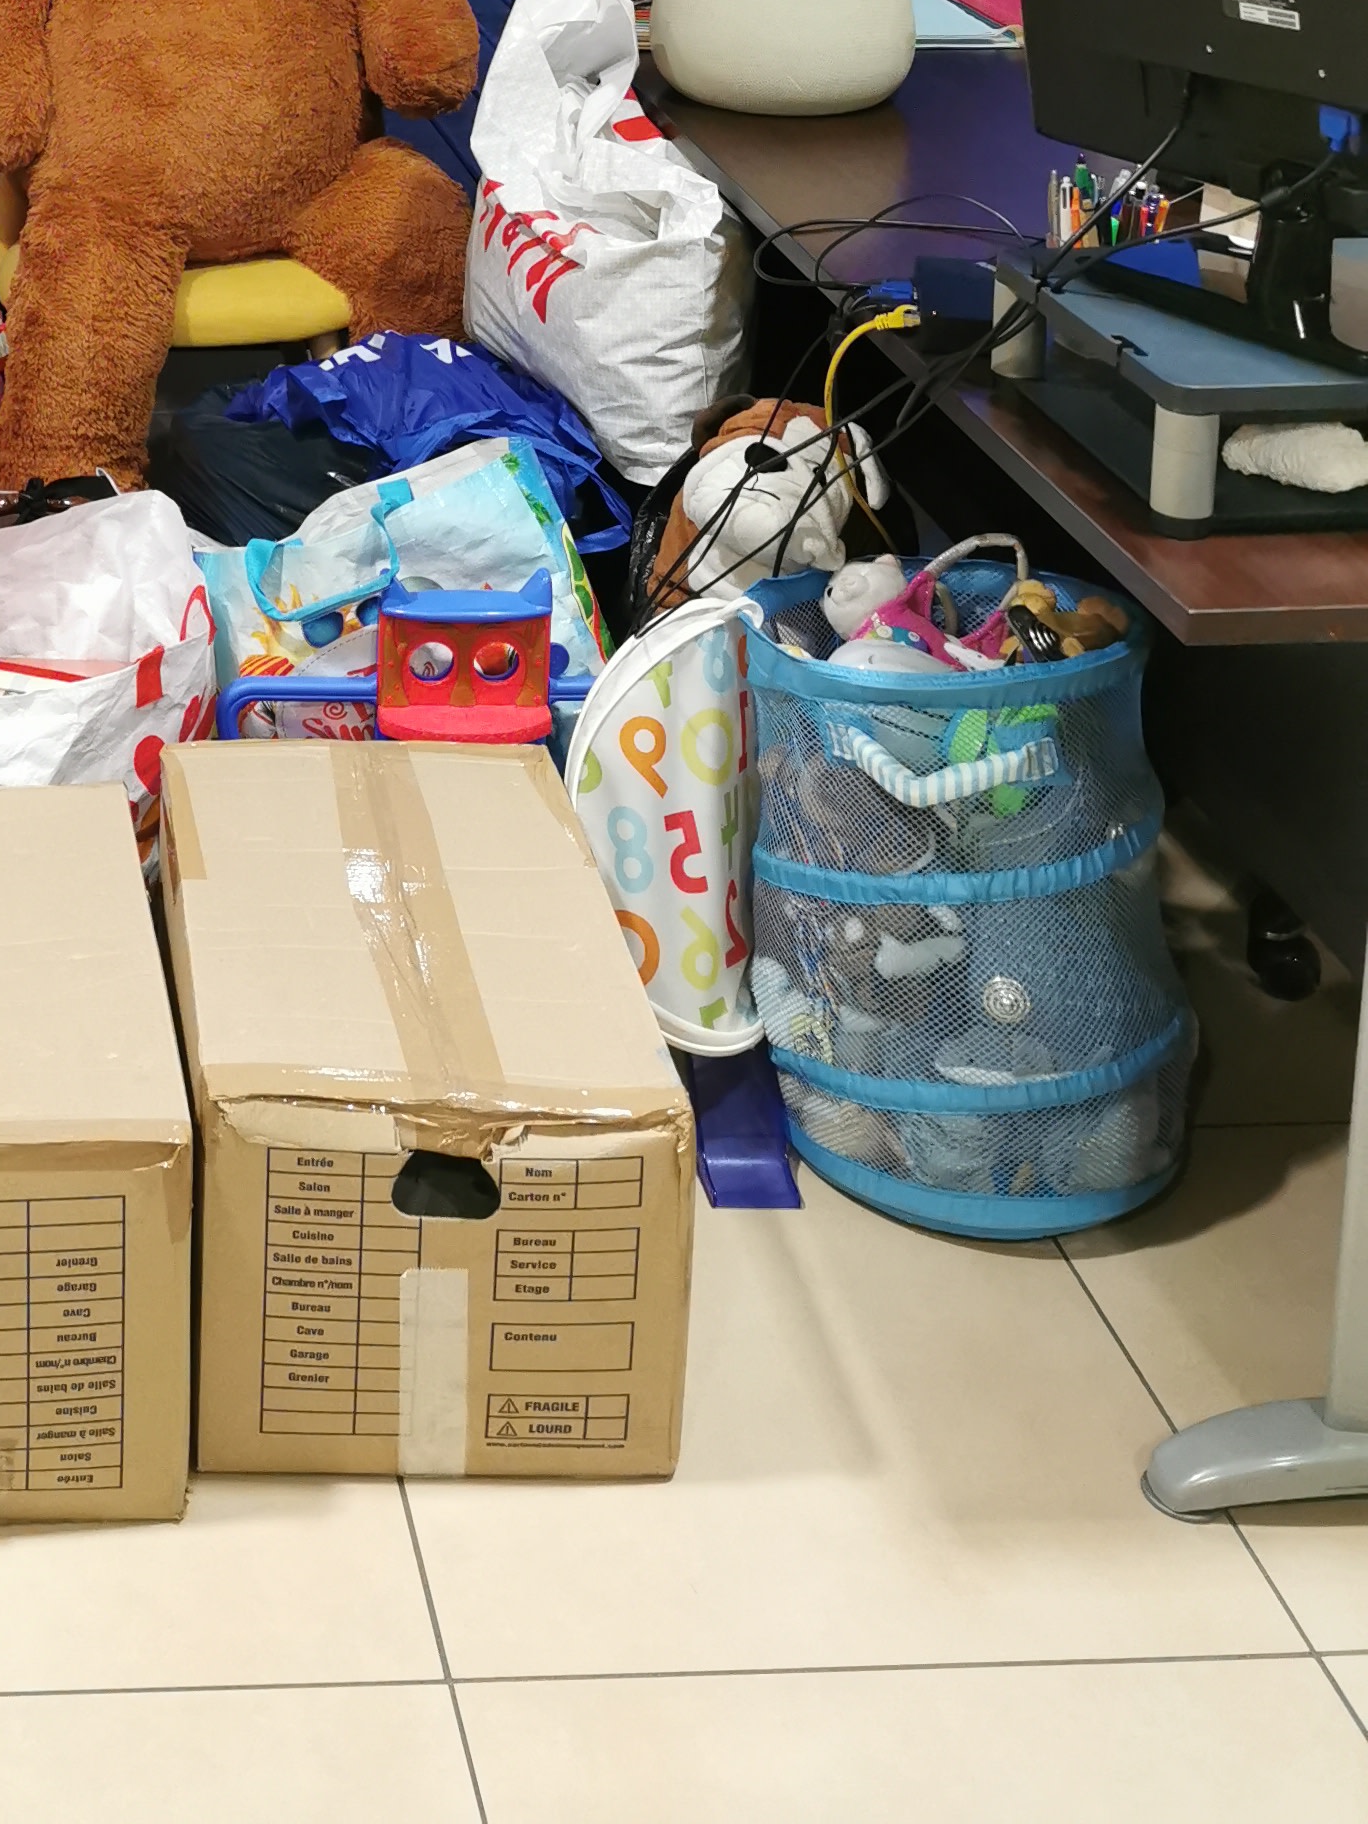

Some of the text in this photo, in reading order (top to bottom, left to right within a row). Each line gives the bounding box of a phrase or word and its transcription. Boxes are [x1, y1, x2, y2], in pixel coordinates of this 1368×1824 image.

[525, 1168, 552, 1177] Nom
[298, 1182, 330, 1192] Salon
[508, 1192, 549, 1201] Carton
[274, 1205, 301, 1215] Salle
[313, 1209, 354, 1220] manger
[292, 1230, 334, 1241] Cuisine
[513, 1238, 556, 1246] Bureau
[56, 1257, 97, 1268] Grenier
[273, 1253, 352, 1266] Salle de bains
[510, 1260, 557, 1269] Service
[57, 1282, 97, 1292] Garage
[515, 1284, 549, 1295] Etage
[292, 1302, 330, 1312] Bureau
[63, 1308, 90, 1317] Cave
[297, 1326, 324, 1335] Cave
[57, 1333, 96, 1342] Bureau
[504, 1332, 557, 1341] Contenu
[290, 1349, 329, 1360] Garage
[289, 1372, 329, 1382] Grenier
[37, 1384, 67, 1393] bains
[88, 1380, 116, 1390] Salle
[56, 1405, 97, 1416] Cuisine
[525, 1402, 579, 1411] FRAGILE
[89, 1428, 115, 1437] Salle
[529, 1424, 572, 1433] LOURD
[37, 1430, 76, 1442] manger
[60, 1452, 91, 1461] Salon
